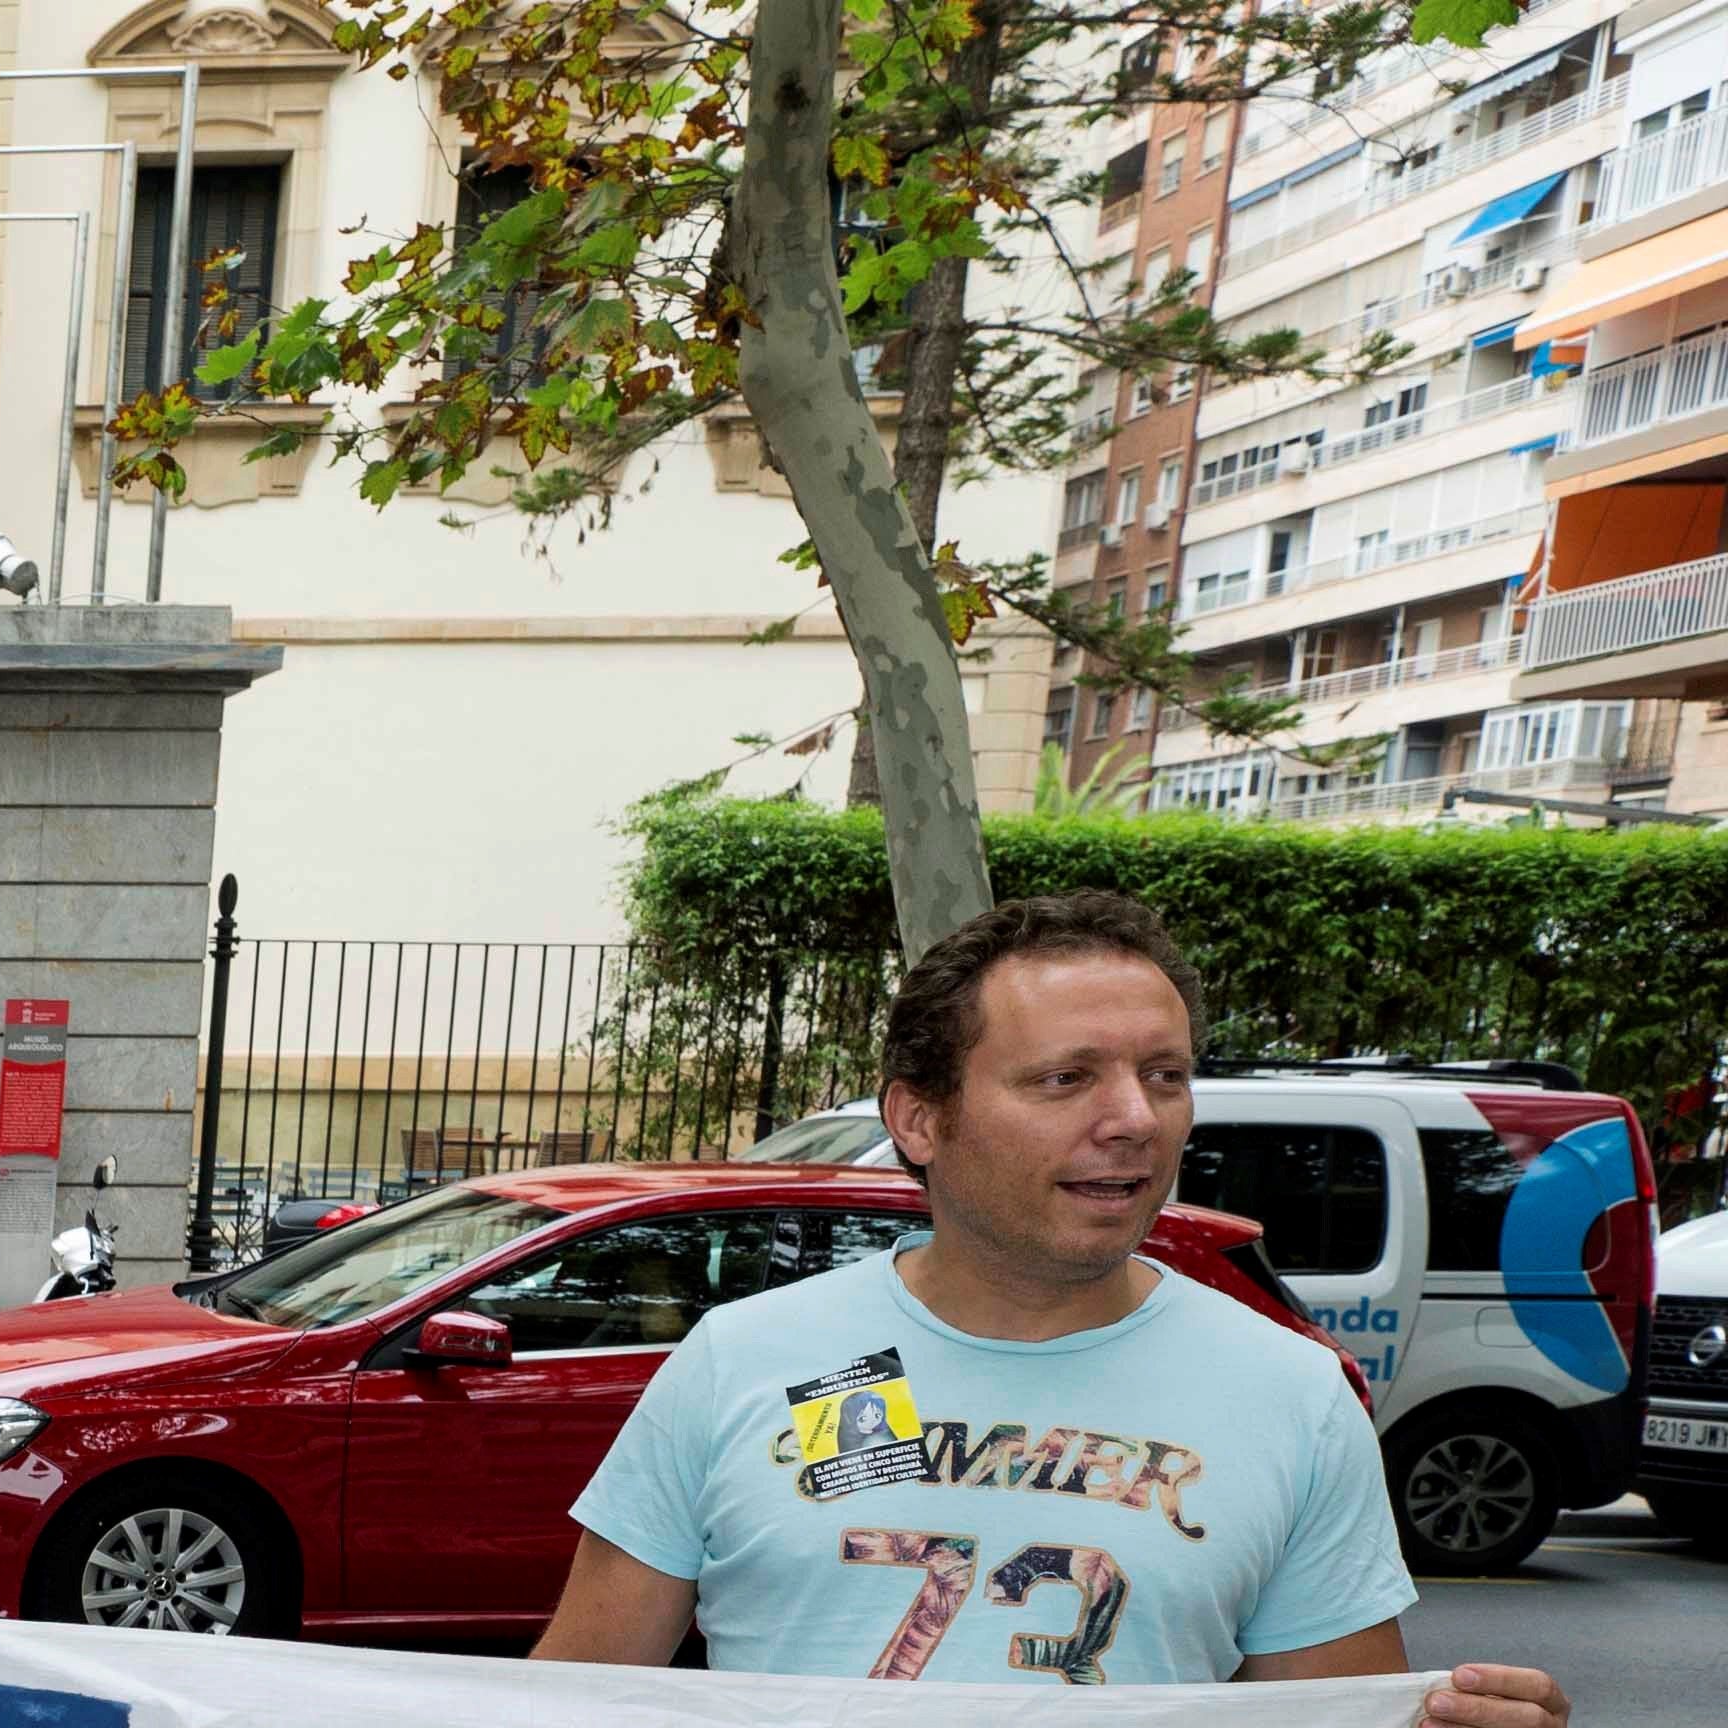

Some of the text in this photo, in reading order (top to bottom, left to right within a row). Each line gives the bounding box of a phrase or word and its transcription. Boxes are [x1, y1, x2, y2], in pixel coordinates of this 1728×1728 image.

[820, 1367, 871, 1385] MIENTEN
[1648, 1420, 1691, 1444] 8219
[823, 1462, 839, 1473] AVE
[863, 1452, 875, 1462] EN
[875, 1443, 921, 1459] SUPERFICIE
[816, 1473, 831, 1483] CON
[858, 1463, 868, 1471] DE
[869, 1457, 891, 1469] CINCO
[876, 1468, 882, 1476] Y
[889, 1473, 895, 1481] Y
[895, 1468, 929, 1481] CULTURA
